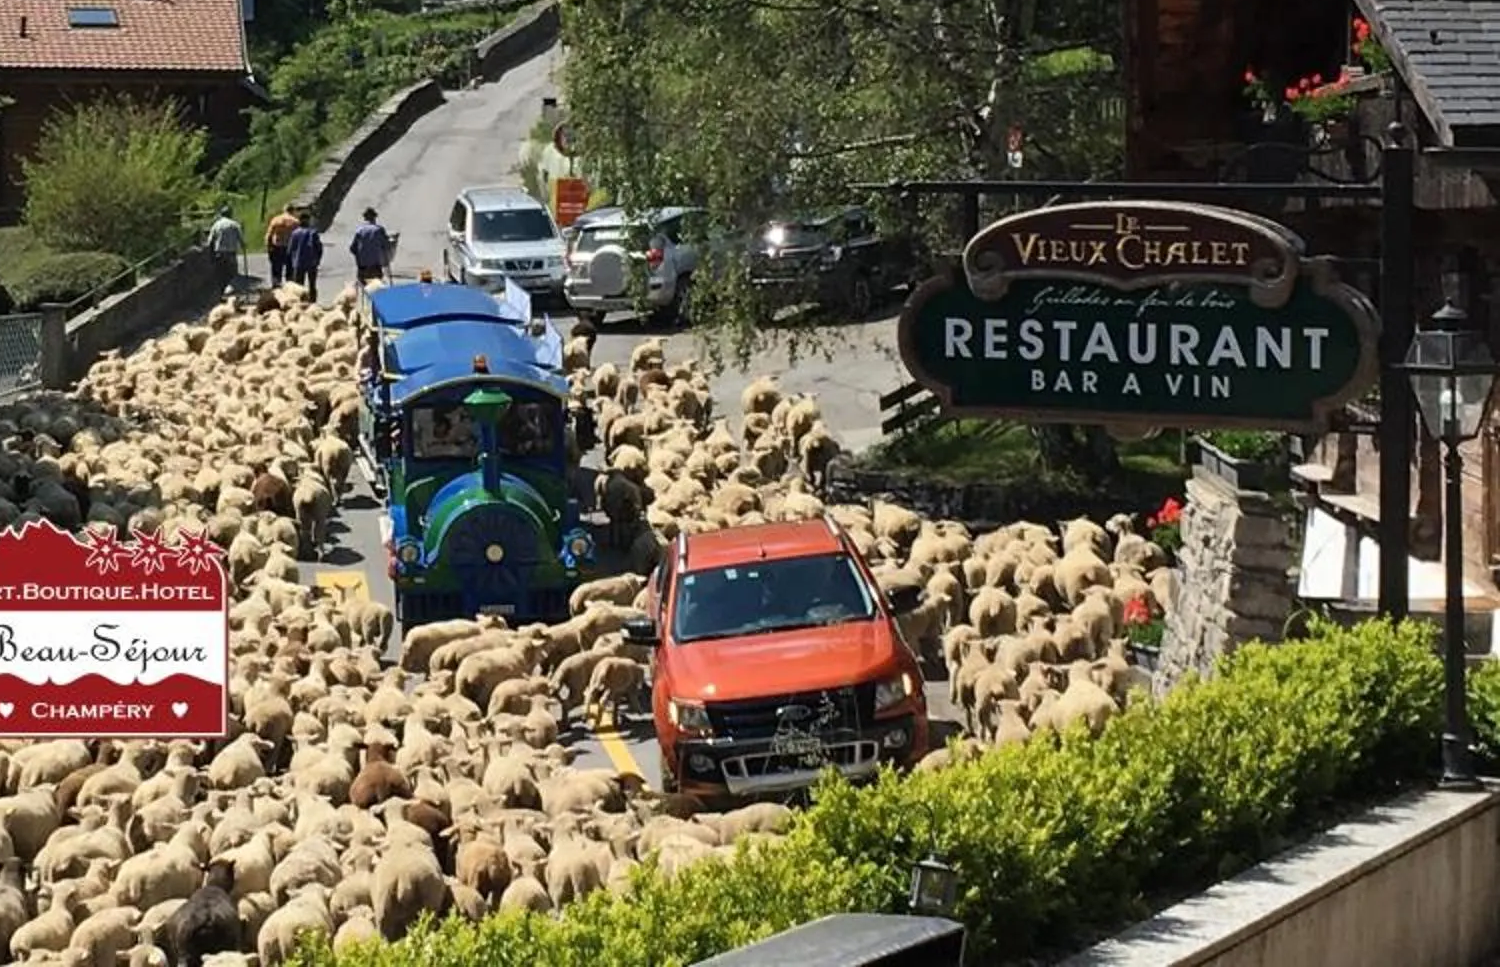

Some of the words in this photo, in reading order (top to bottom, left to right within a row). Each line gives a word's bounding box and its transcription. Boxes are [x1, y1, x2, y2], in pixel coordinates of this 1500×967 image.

[1011, 233, 1108, 266] VIEUX
[1116, 234, 1250, 269] CHALET
[944, 317, 1330, 370] RESTAURANT
[1031, 370, 1098, 394] BAR
[1122, 373, 1142, 396] A
[1165, 375, 1231, 399] VIN
